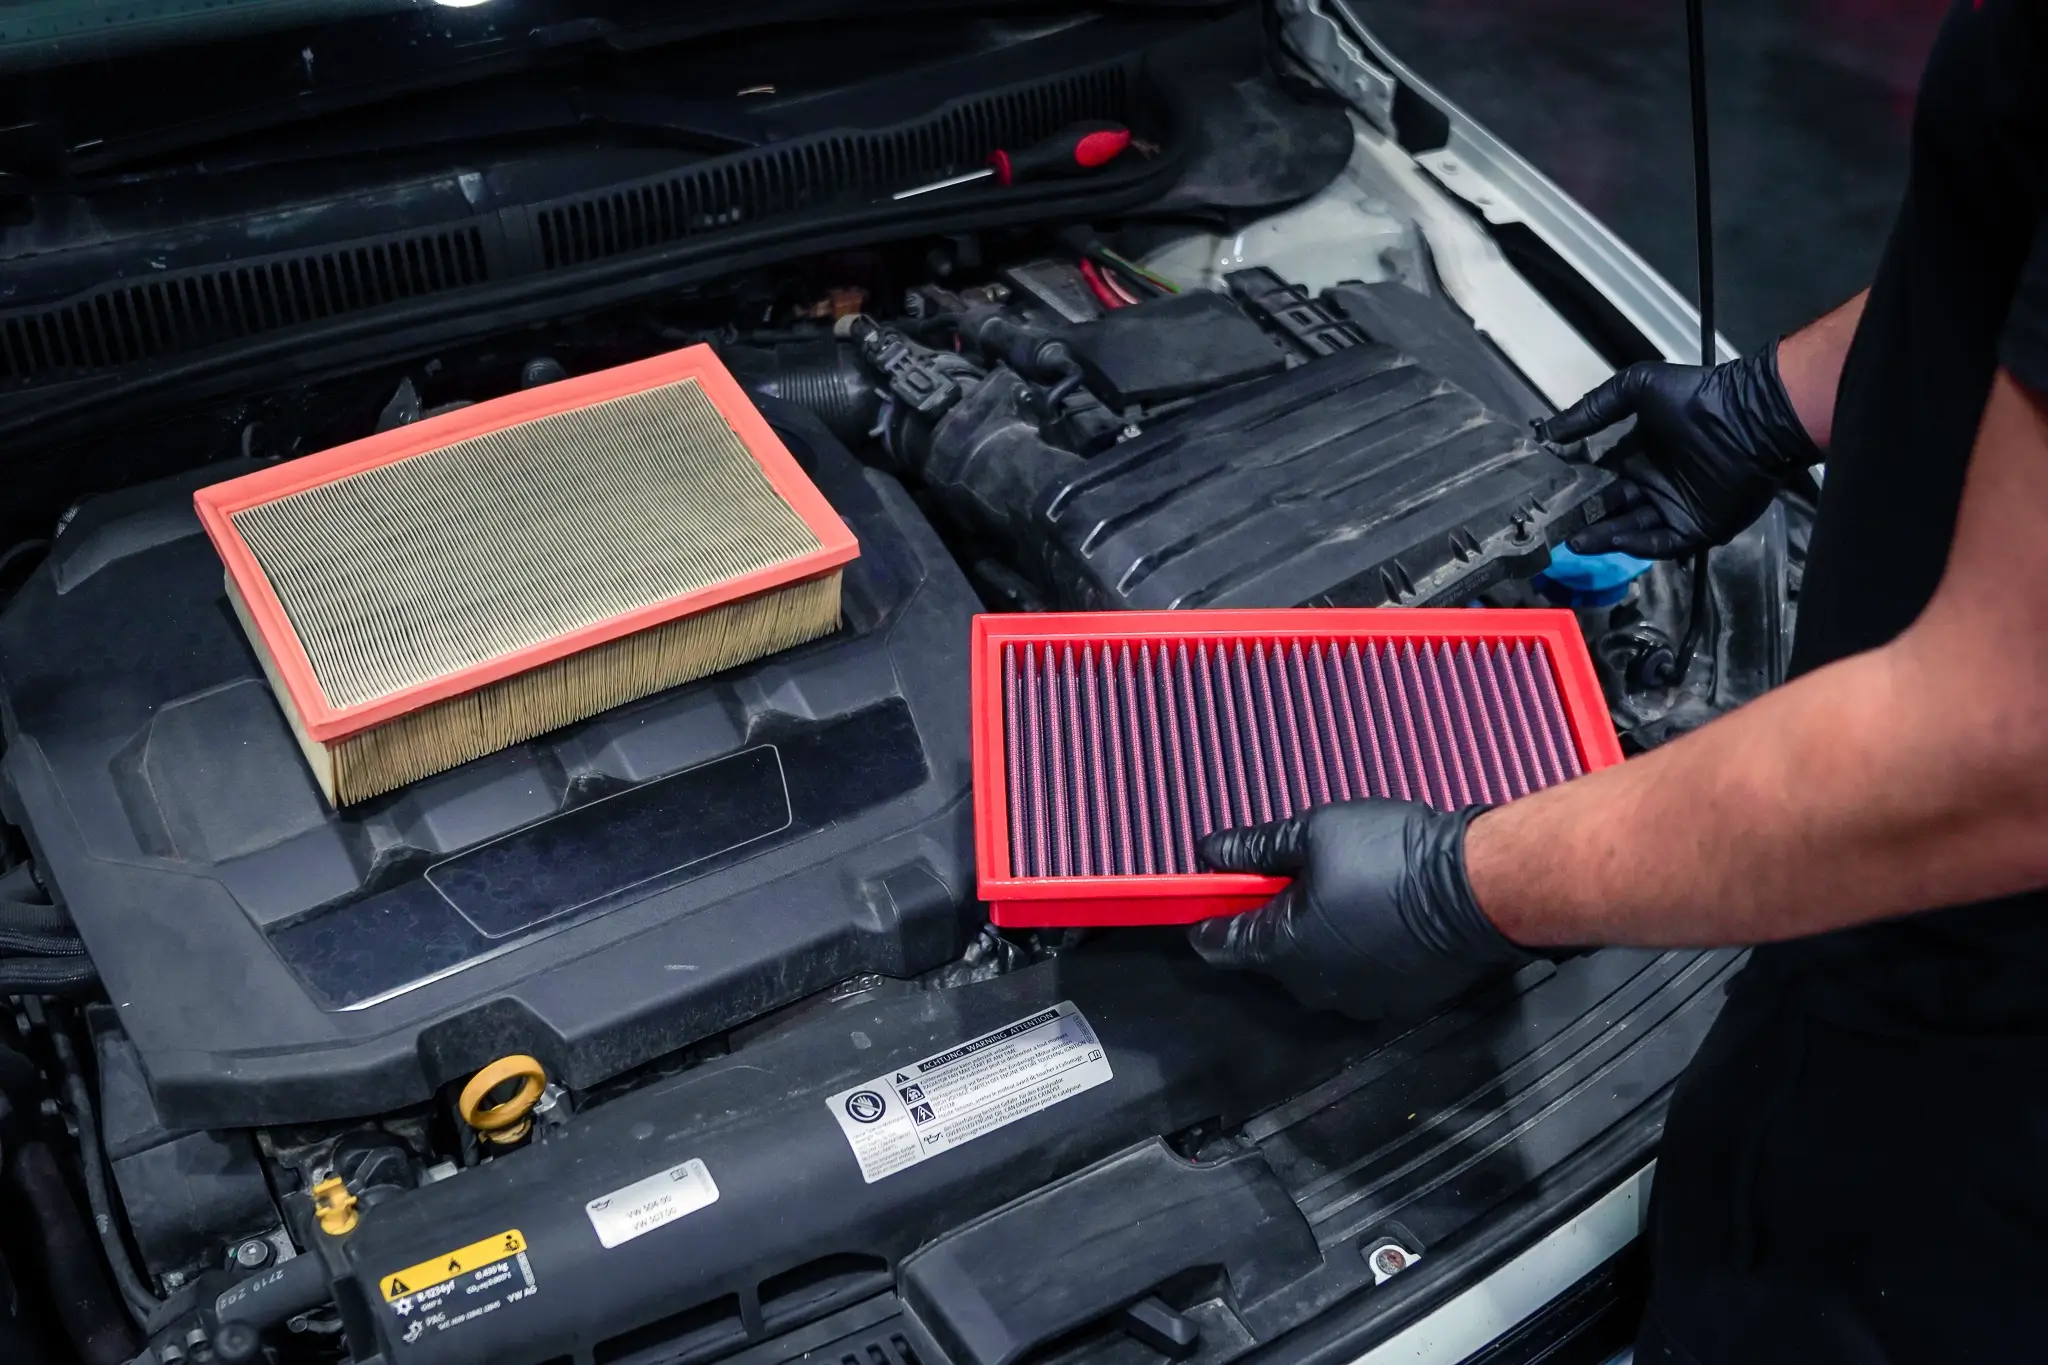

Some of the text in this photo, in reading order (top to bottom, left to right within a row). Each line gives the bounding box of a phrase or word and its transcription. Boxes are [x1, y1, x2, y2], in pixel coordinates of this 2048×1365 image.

[923, 1048, 963, 1070] ACHTUNG
[967, 1032, 1007, 1051] WARNING
[1010, 1012, 1053, 1034] ATTENTION
[625, 1207, 642, 1218] VW
[632, 1218, 648, 1229] VW
[506, 1290, 523, 1303] VW
[521, 1284, 538, 1297] AG
[425, 1312, 447, 1325] PAG
